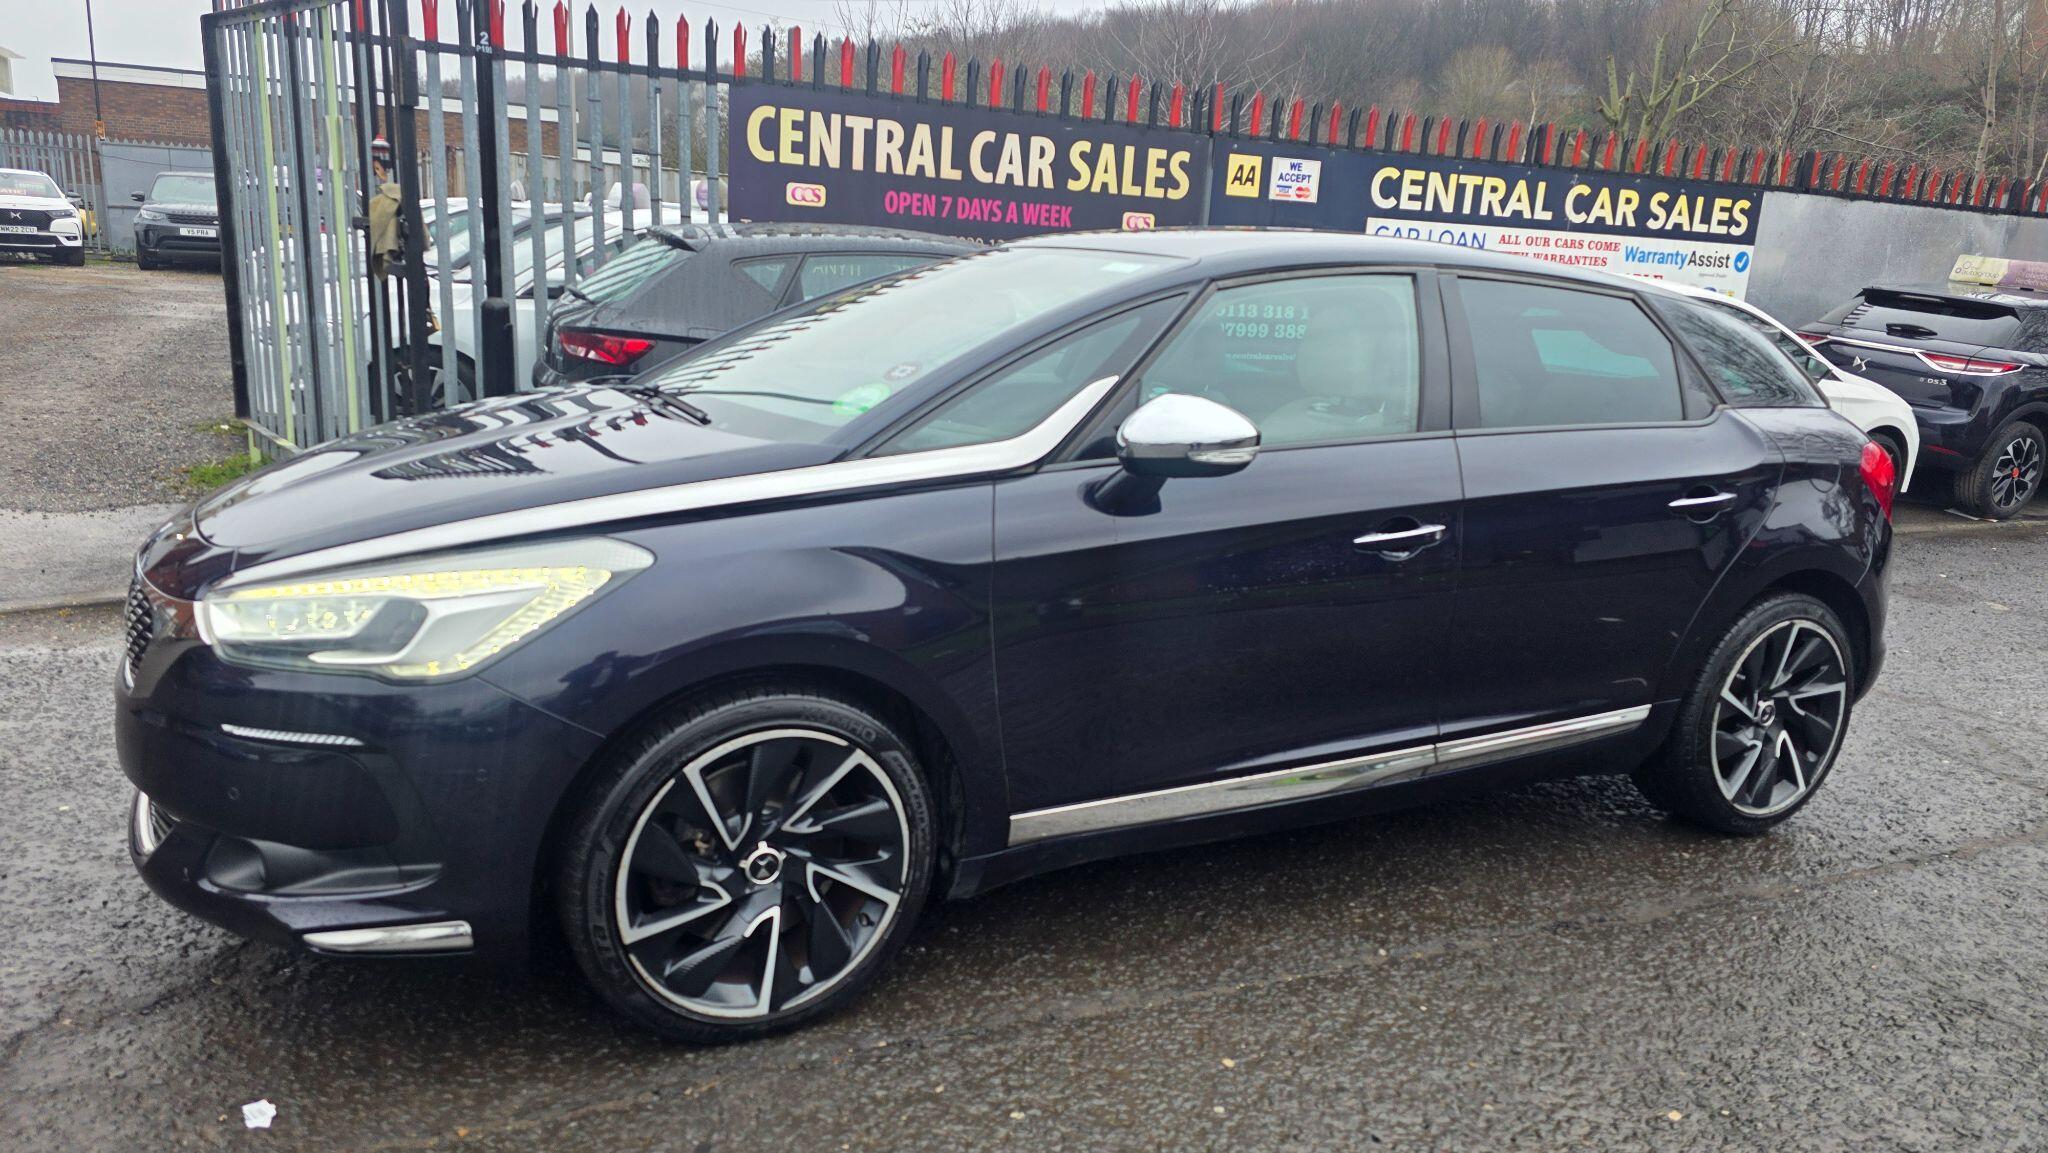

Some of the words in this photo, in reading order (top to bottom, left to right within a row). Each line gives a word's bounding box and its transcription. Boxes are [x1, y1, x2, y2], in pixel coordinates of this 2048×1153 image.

[480, 31, 489, 45] 2
[746, 104, 962, 182] CENTRAL
[969, 130, 1057, 190] CAR
[1067, 139, 1192, 200] SALES
[1290, 162, 1303, 171] WE
[1231, 164, 1256, 187] AA
[1278, 172, 1312, 184] ACCEPT
[884, 190, 936, 217] OPEN
[941, 197, 953, 218] 7
[957, 197, 1001, 223] DAYS
[1005, 202, 1018, 224] A
[1022, 203, 1072, 228] WEEK
[1371, 166, 1553, 220] CENTRAL
[1564, 184, 1640, 227] CAR
[1646, 191, 1751, 236] SALES
[1499, 234, 1521, 245] ALL
[1525, 236, 1550, 247] OUR
[1555, 238, 1584, 249] CARS
[1588, 241, 1621, 252] COME
[1533, 253, 1608, 267] WARRANTIES
[1264, 305, 1294, 319] 318
